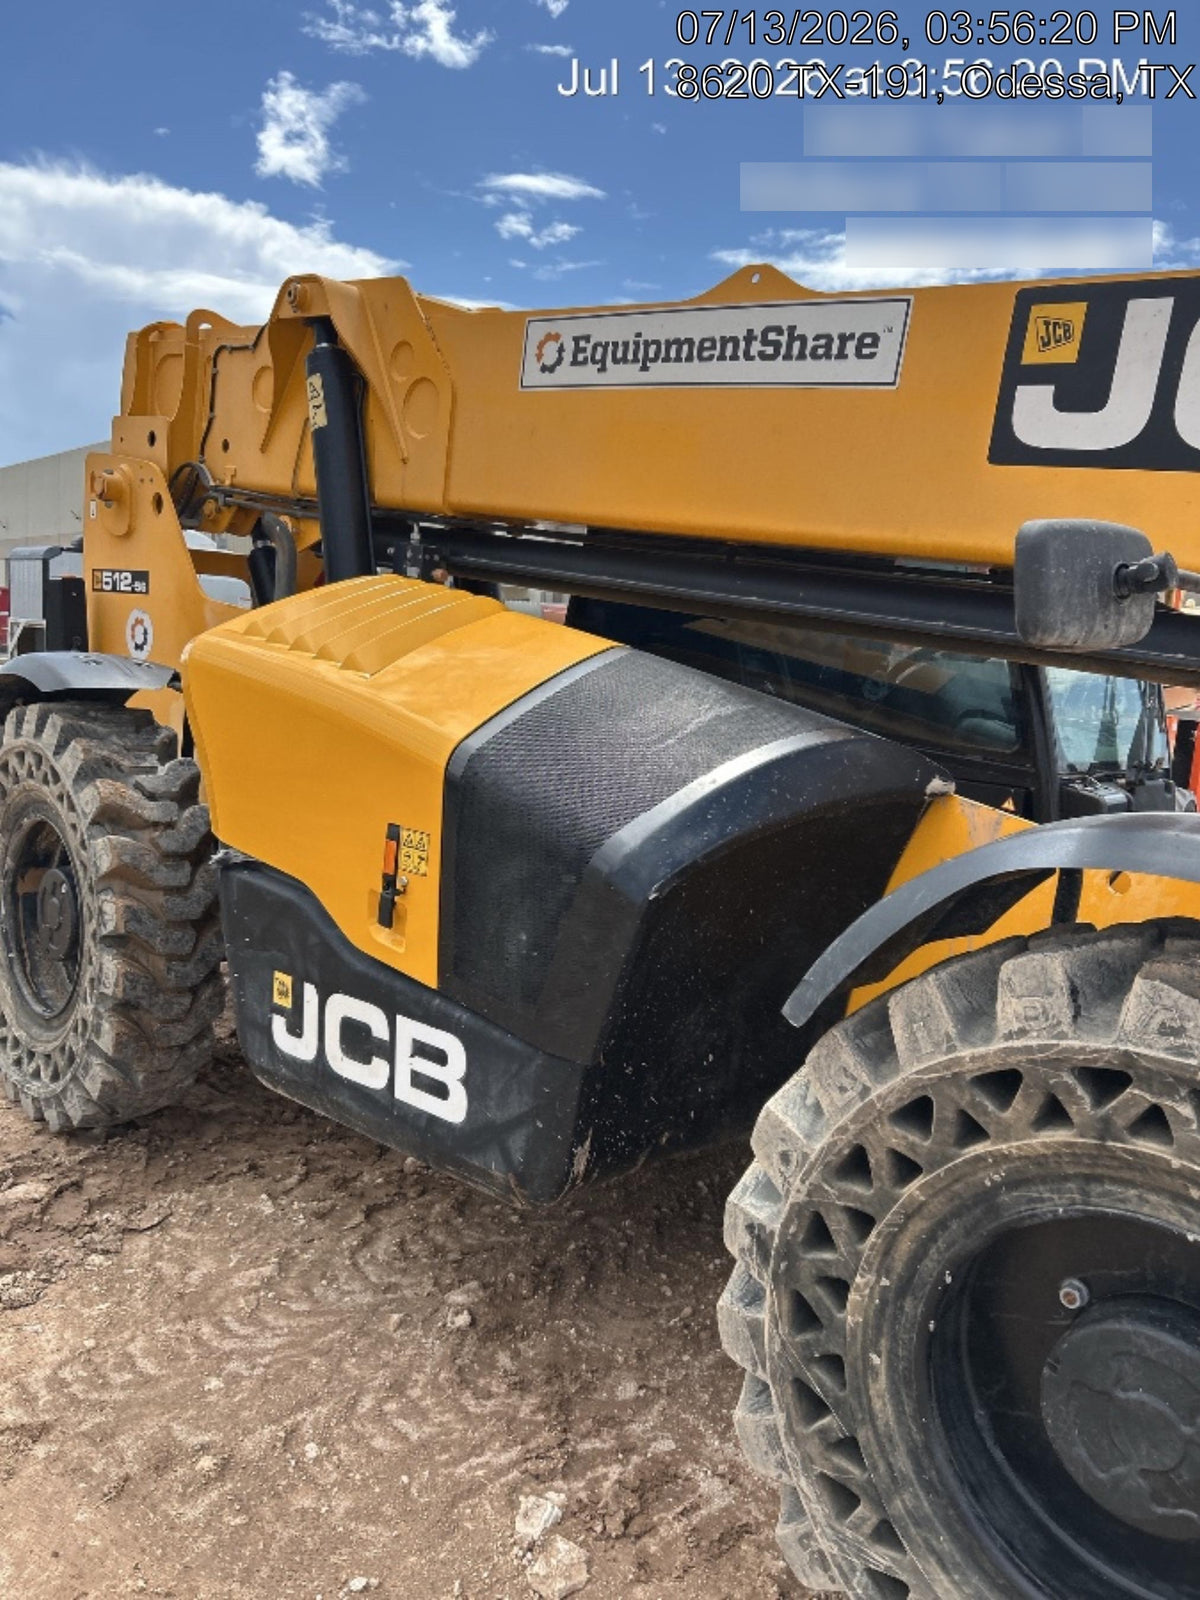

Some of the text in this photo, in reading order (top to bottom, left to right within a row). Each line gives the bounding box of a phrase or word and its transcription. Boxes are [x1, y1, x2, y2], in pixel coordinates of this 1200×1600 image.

[570, 325, 880, 373] EquipmentShare
[1038, 318, 1074, 349] JCB
[271, 982, 468, 1124] JCB
